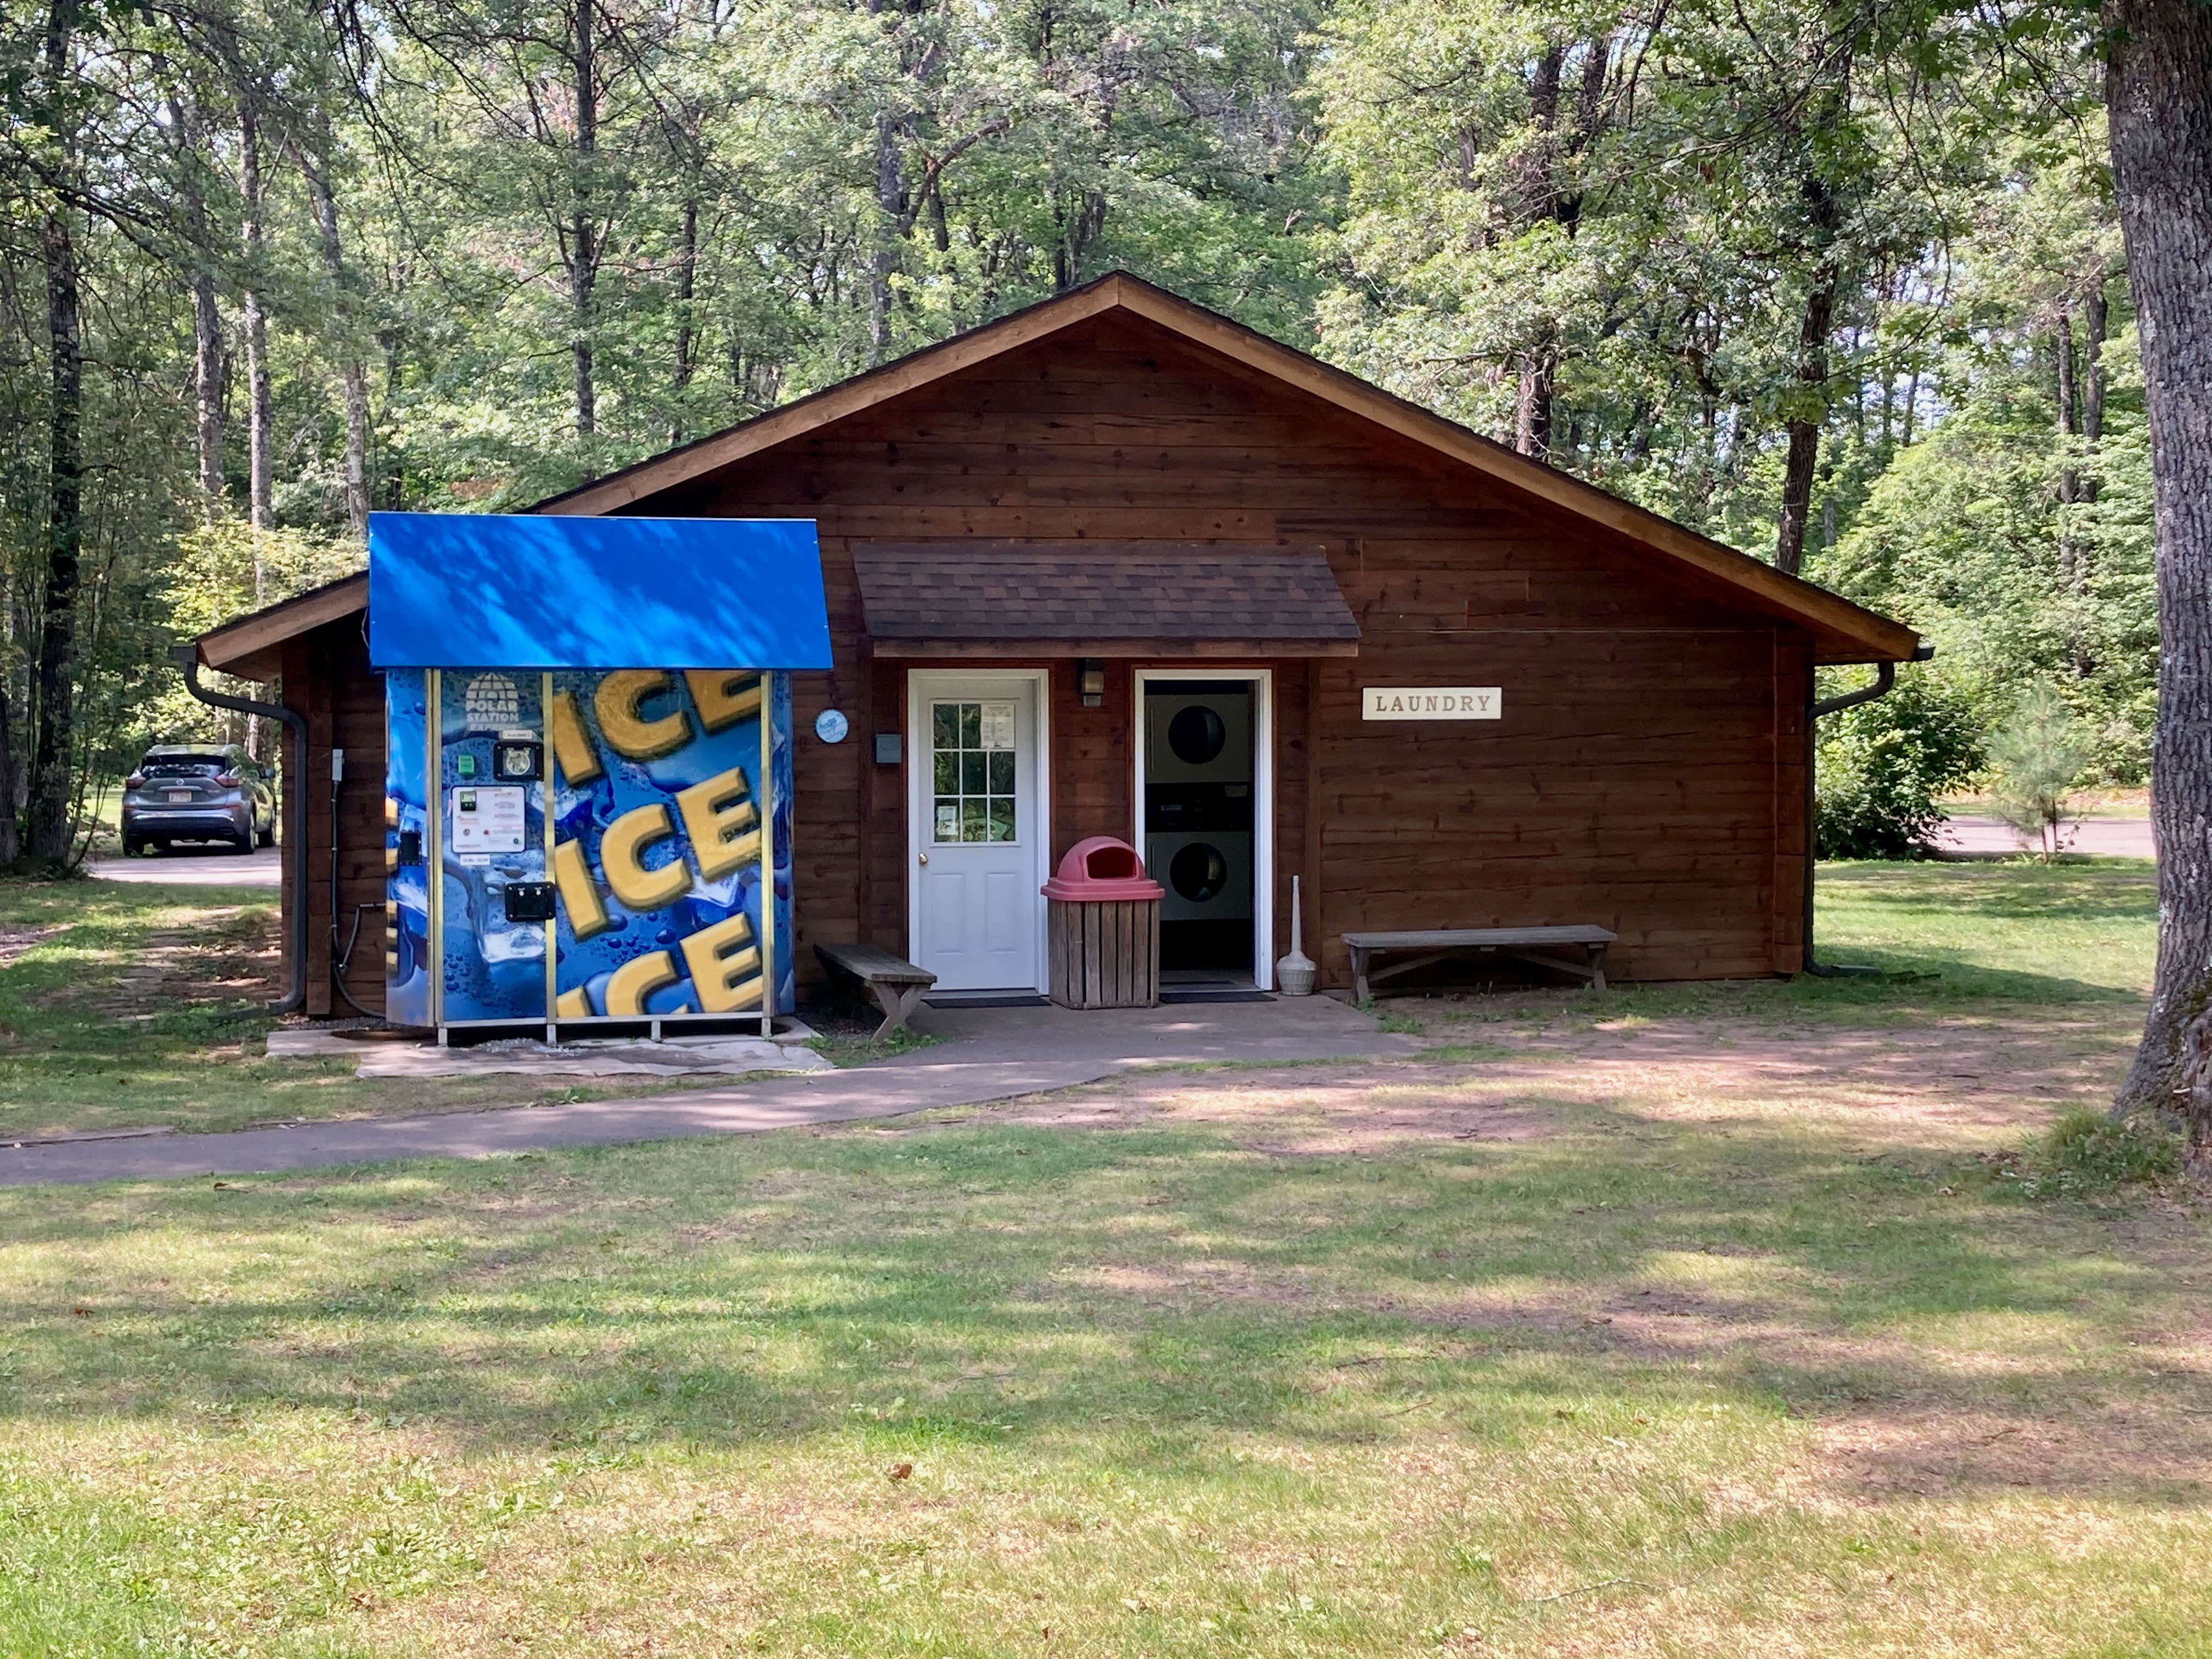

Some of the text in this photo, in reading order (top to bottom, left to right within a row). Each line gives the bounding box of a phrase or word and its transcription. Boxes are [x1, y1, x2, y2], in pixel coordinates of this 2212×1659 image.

[466, 700, 518, 712] POLAR
[1376, 696, 1490, 712] LAUNDRY
[467, 713, 518, 722] STATION
[552, 670, 761, 786] ICE
[554, 766, 762, 941] ICE
